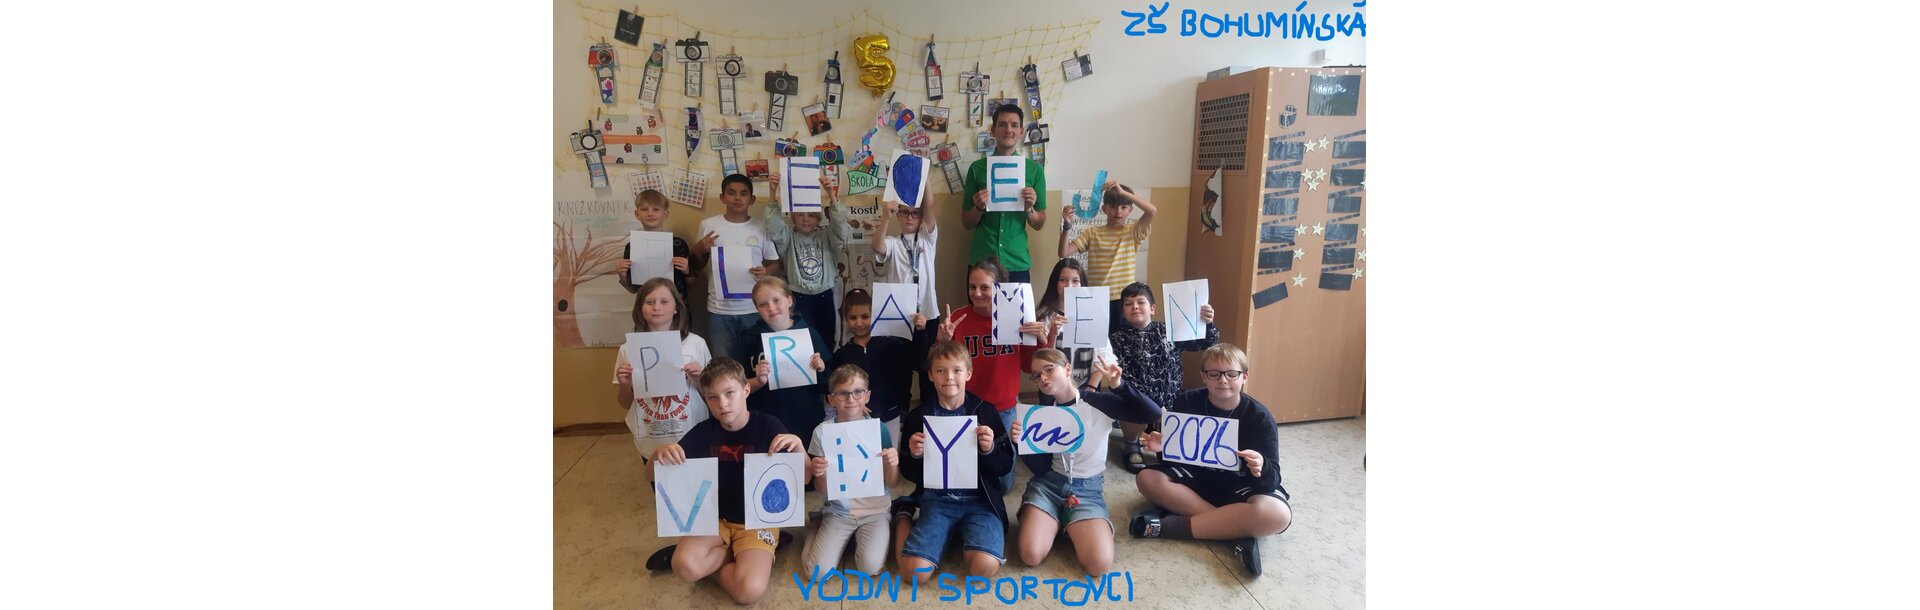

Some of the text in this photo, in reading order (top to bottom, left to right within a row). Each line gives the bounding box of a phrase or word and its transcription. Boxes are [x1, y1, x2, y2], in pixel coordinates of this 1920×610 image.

[851, 175, 875, 188] ŠKOLA
[990, 162, 1019, 204] E
[1071, 168, 1108, 219] J
[850, 205, 877, 215] kosti
[717, 246, 753, 300] L
[870, 293, 914, 336] A
[1073, 296, 1094, 345] E
[1168, 290, 1198, 342] N
[639, 346, 660, 392] P
[768, 335, 814, 390] R
[922, 415, 973, 490] Y
[1162, 414, 1239, 468] 2026
[656, 479, 713, 533] V
